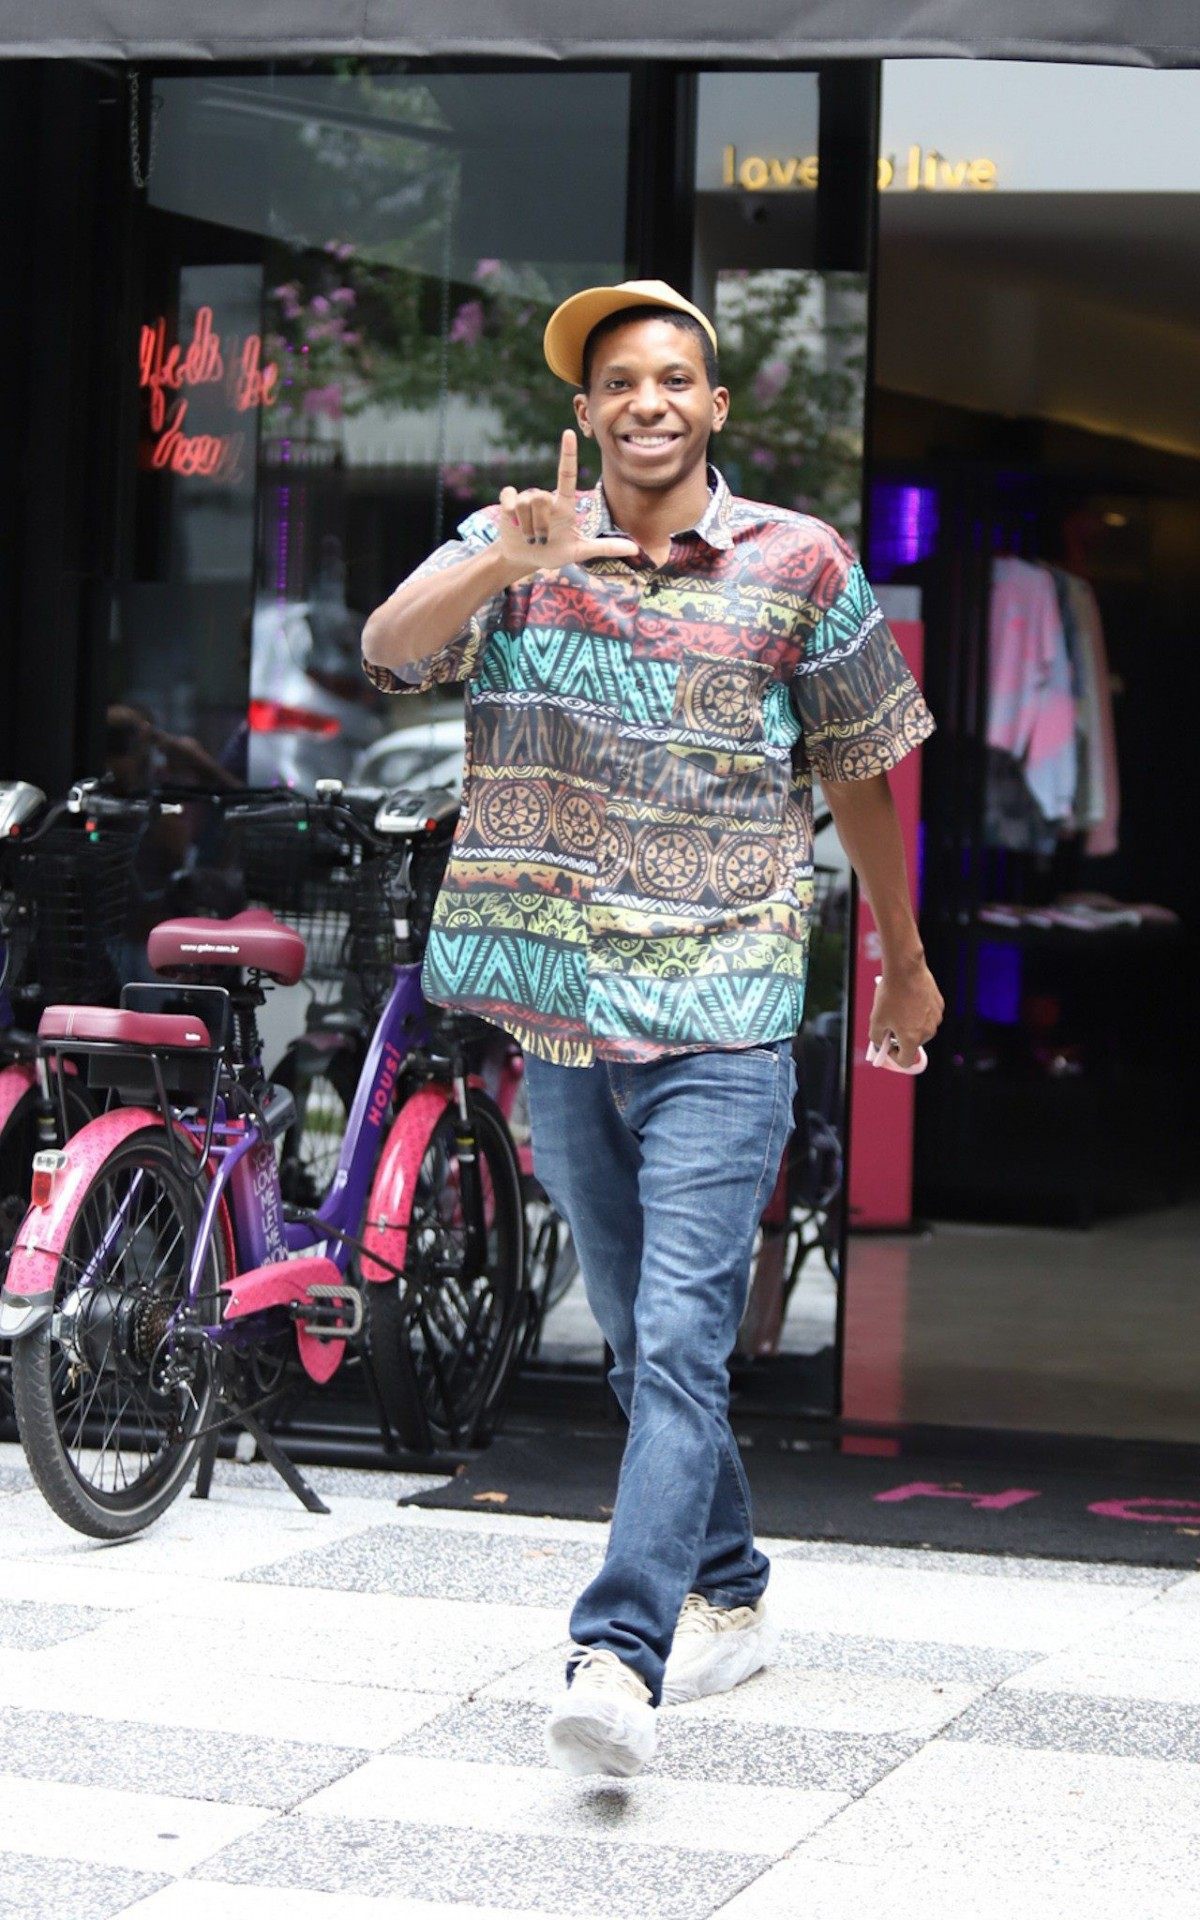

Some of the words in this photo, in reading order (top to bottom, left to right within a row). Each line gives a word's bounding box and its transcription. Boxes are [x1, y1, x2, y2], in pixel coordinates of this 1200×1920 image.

[722, 143, 819, 191] love
[907, 143, 997, 190] live
[253, 1160, 279, 1197] LOVE
[261, 1184, 277, 1211] ME
[262, 1203, 278, 1233] LET
